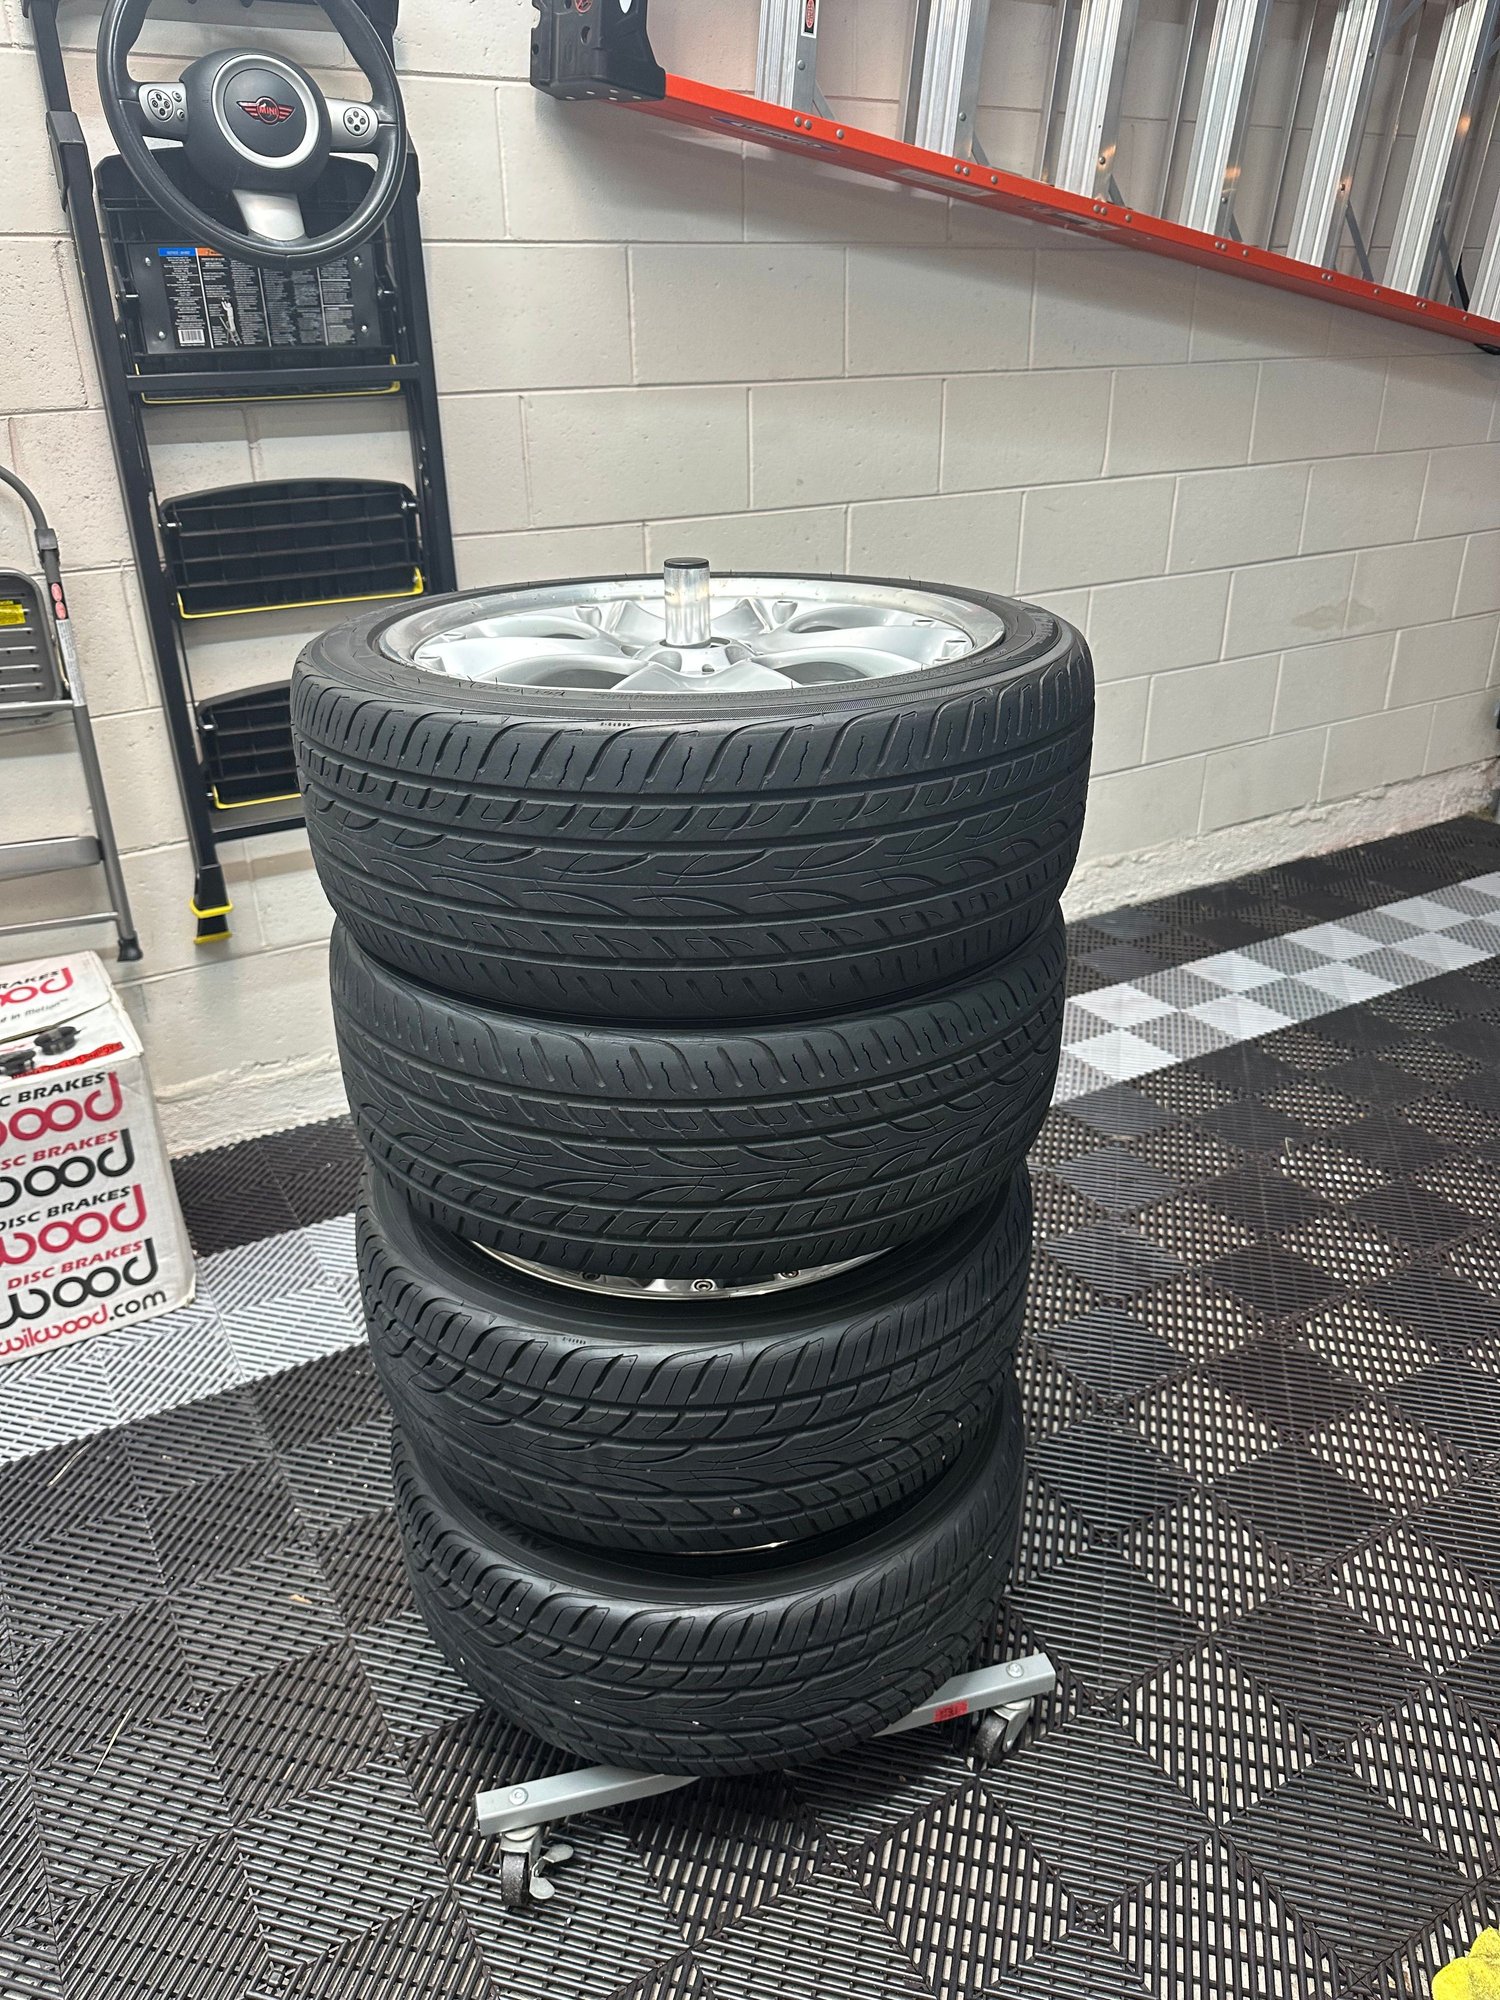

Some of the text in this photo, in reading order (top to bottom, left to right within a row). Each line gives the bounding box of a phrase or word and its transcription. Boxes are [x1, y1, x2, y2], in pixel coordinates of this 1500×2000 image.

[259, 105, 277, 116] MINI
[18, 1071, 106, 1104] BRAKES
[32, 1130, 119, 1162] BRAKES
[46, 1185, 131, 1218] BRAKES
[8, 1240, 143, 1290] DISC BRAKES
[0, 1289, 167, 1356] wilwood.com
